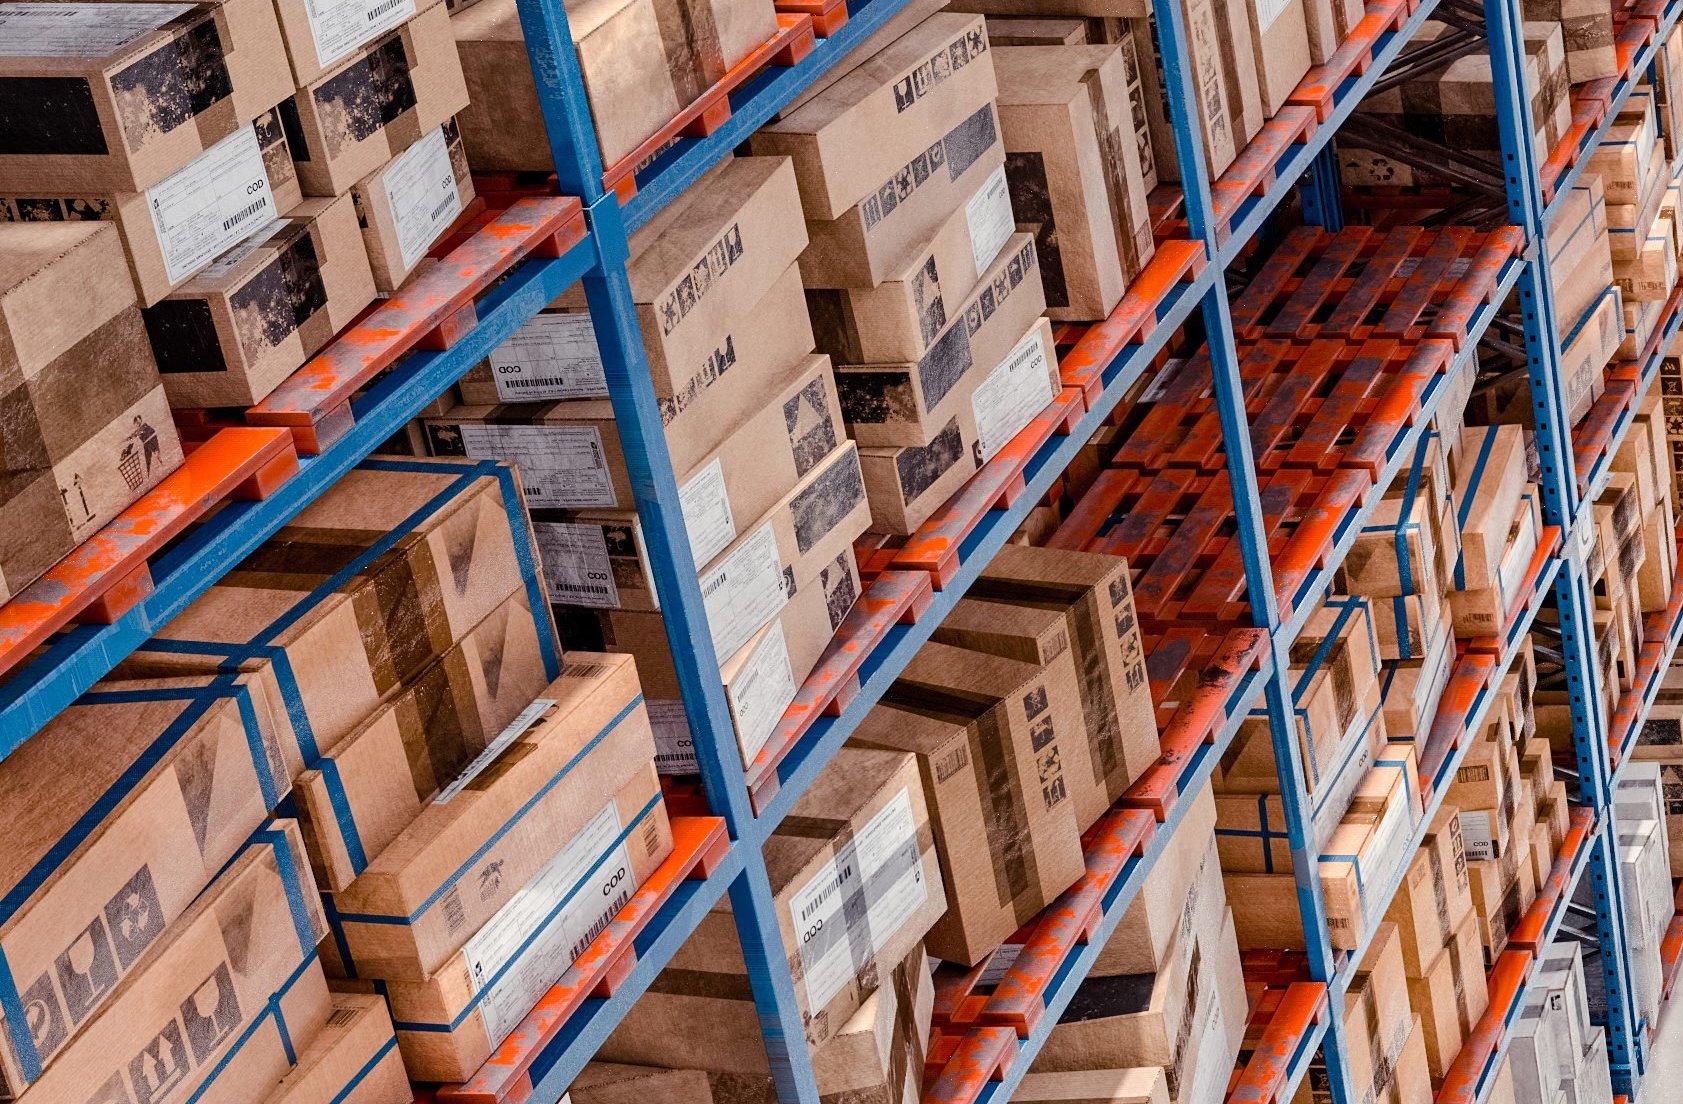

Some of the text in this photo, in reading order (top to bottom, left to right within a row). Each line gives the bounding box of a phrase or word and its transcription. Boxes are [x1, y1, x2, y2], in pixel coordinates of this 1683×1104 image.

[246, 179, 264, 195] COD
[1030, 354, 1042, 369] COD
[498, 365, 522, 374] COD
[587, 571, 608, 580] COD
[602, 867, 626, 897] COD
